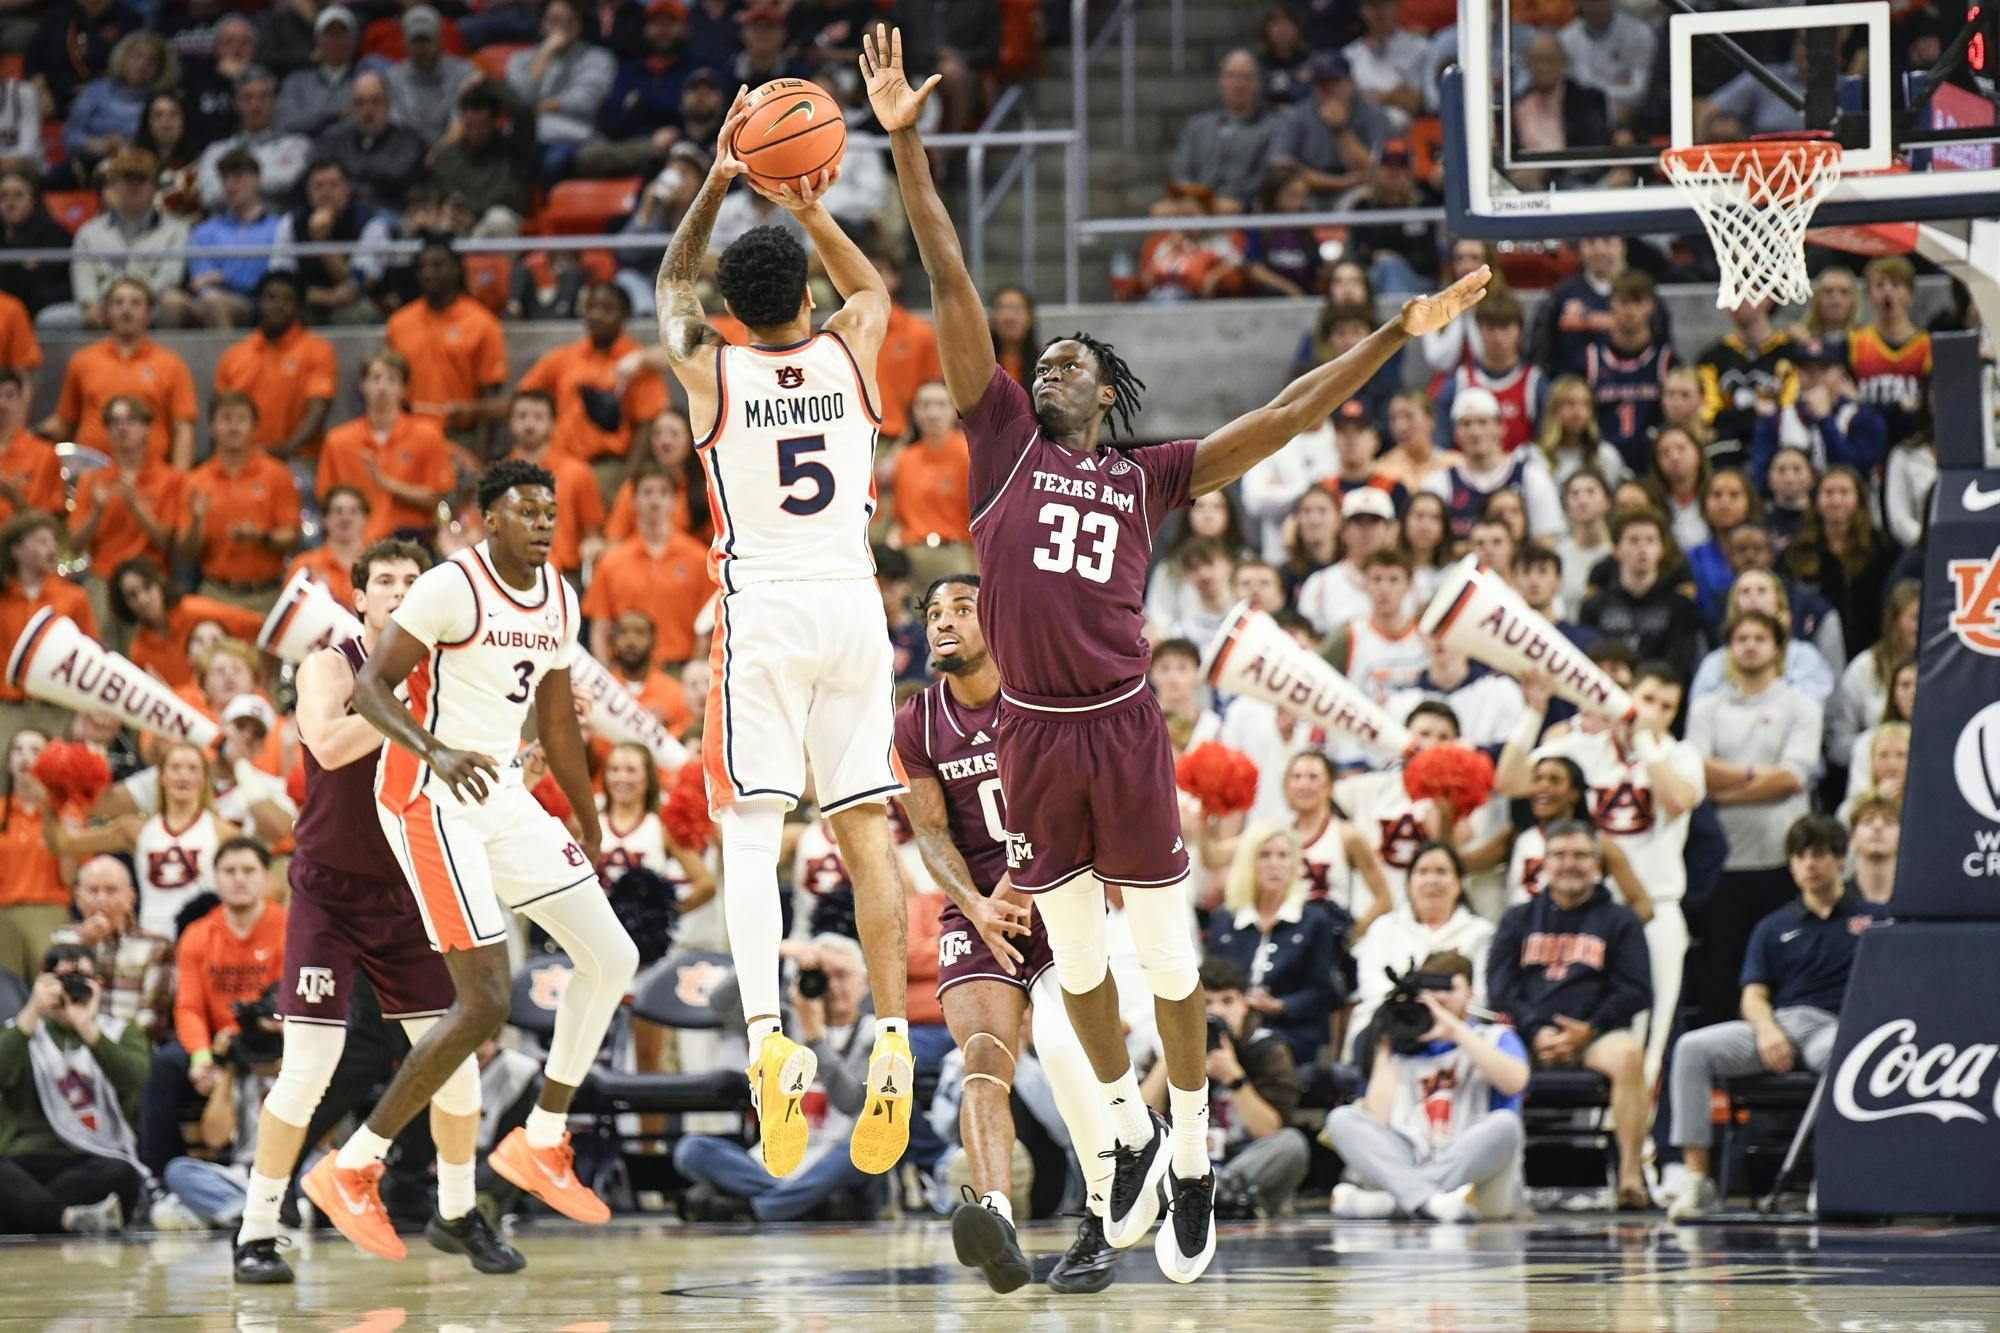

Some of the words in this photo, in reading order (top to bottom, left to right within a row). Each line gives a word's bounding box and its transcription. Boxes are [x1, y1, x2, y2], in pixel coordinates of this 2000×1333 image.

[745, 392, 844, 428] MAGWOOD
[776, 433, 836, 516] 5
[1033, 471, 1097, 500] TEXAS
[1033, 503, 1119, 584] 33
[481, 630, 560, 652] AUBURN
[1480, 605, 1609, 706] AUBURN
[51, 649, 194, 737] AUBURN
[505, 660, 535, 704] 3
[1240, 655, 1380, 740] AUBURN
[938, 752, 997, 781] TEXAS
[1833, 1018, 1999, 1124] Coca
